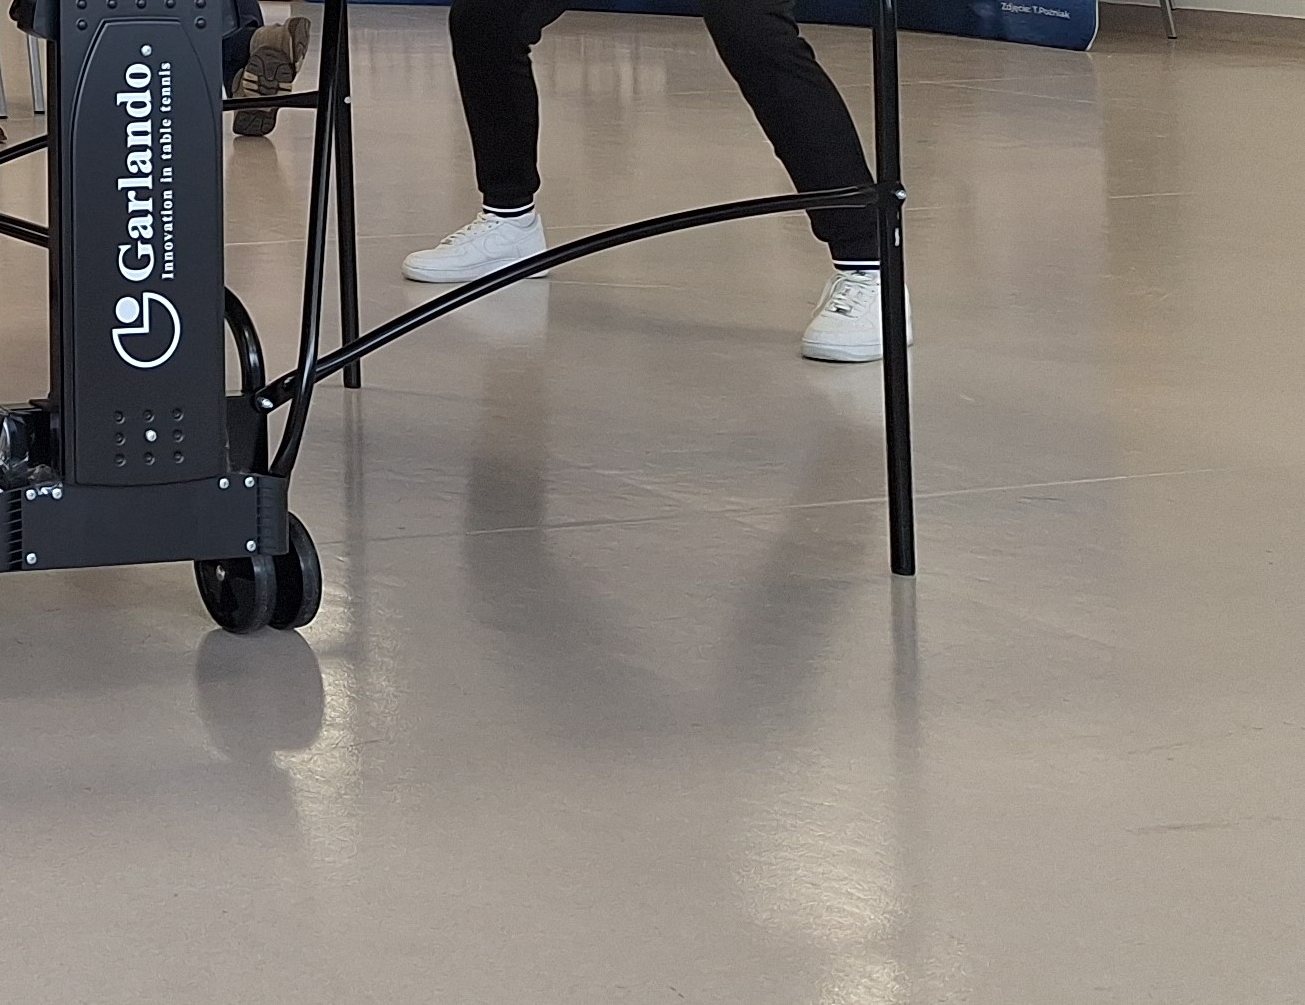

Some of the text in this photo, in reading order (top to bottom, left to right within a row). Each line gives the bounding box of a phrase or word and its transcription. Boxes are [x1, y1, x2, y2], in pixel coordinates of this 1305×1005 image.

[116, 63, 155, 281] Garlando
[158, 62, 174, 280] Innovation in table tennis
